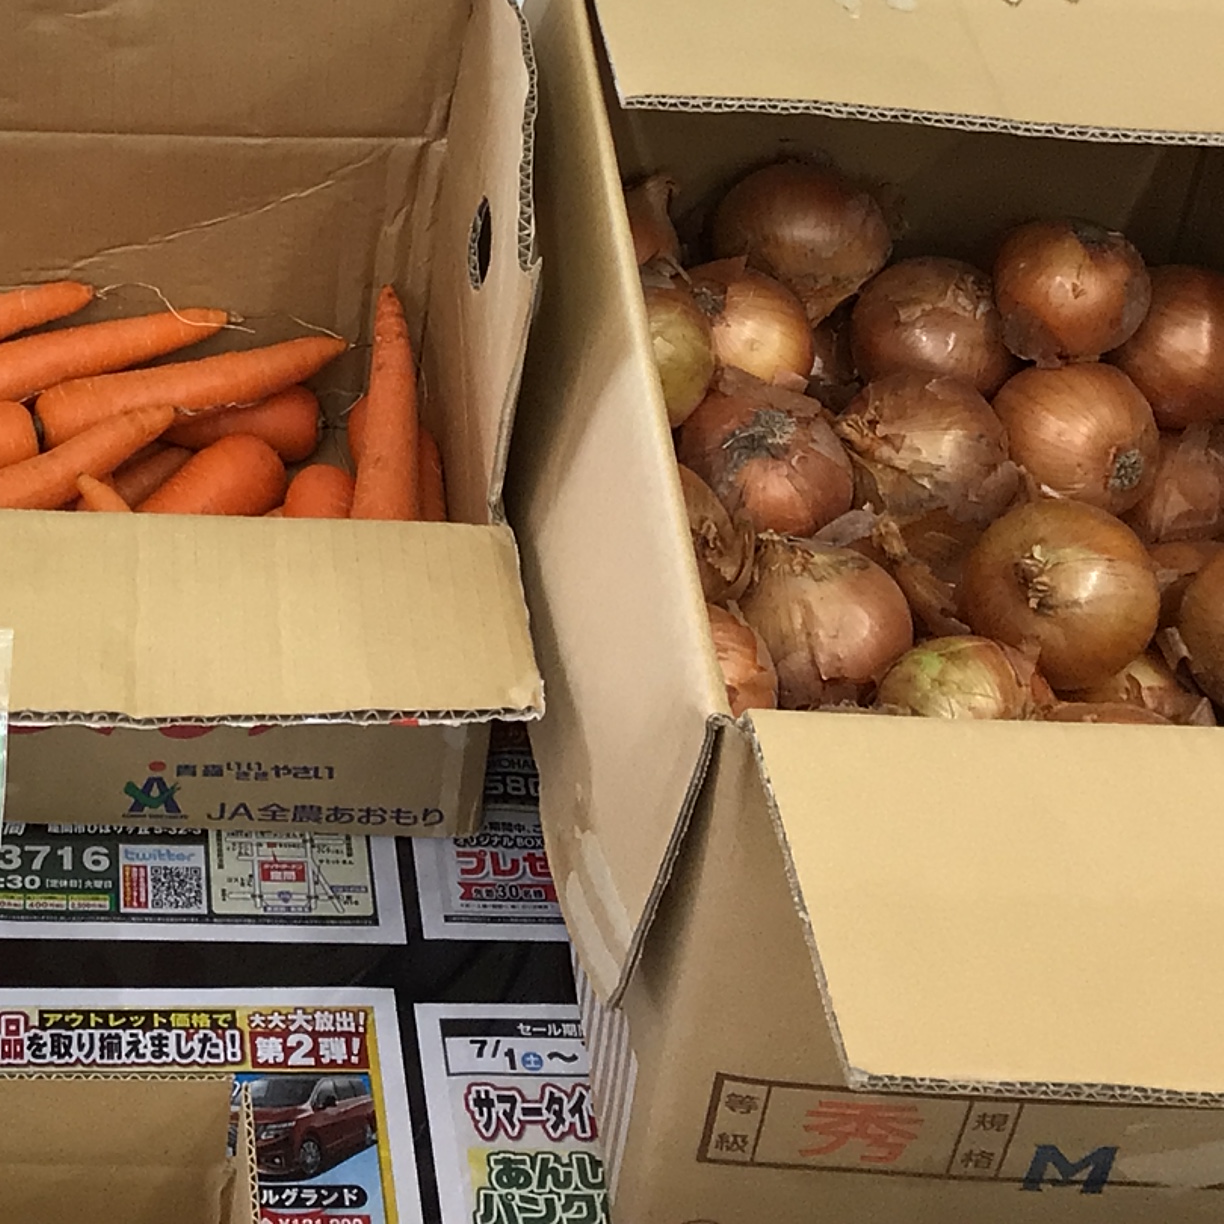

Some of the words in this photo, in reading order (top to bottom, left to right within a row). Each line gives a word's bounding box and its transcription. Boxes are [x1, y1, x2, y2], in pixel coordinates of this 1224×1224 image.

[207, 802, 445, 827] JA全農あおもり
[123, 848, 195, 862] twitter
[42, 1012, 233, 1028] アウトレット価格で
[517, 1022, 583, 1036] セール期
[798, 1099, 925, 1166] 秀
[1019, 1143, 1121, 1195] M
